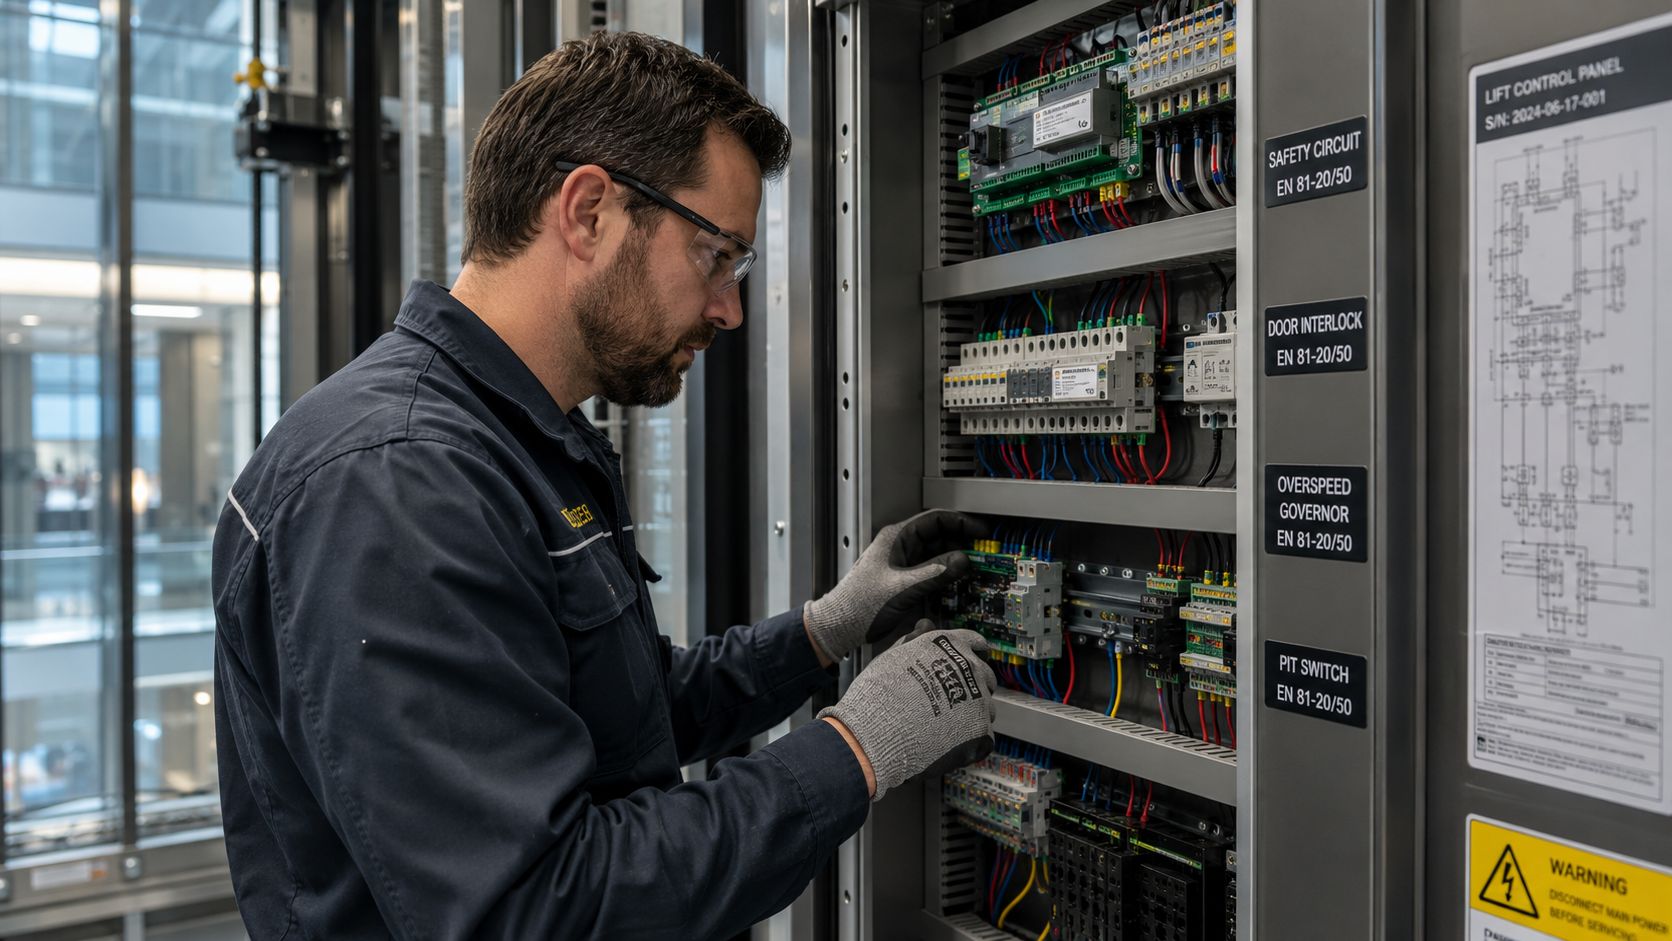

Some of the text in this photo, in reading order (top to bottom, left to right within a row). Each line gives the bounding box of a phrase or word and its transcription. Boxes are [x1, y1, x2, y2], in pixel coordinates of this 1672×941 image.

[1485, 56, 1624, 104] LIFT CONTROL PANEL
[1485, 113, 1510, 130] S/N:
[1269, 131, 1361, 168] SAFETY CIRCUIT
[1277, 165, 1352, 197] EN 81-20/50
[1268, 311, 1362, 337] DOOR INTERLOCK
[1277, 344, 1352, 366] EN 81-20/50
[1278, 476, 1352, 495] OVERSPEED
[1280, 503, 1349, 523] GOVERNOR
[1277, 530, 1352, 552] EN 81-20/50
[1280, 654, 1349, 684] PIT SWITCH
[1277, 684, 1352, 715] EN 81-20/50
[1550, 858, 1628, 896] WARNING
[1550, 889, 1603, 914] DISCONNECT
[1550, 907, 1584, 927] BEFORE
